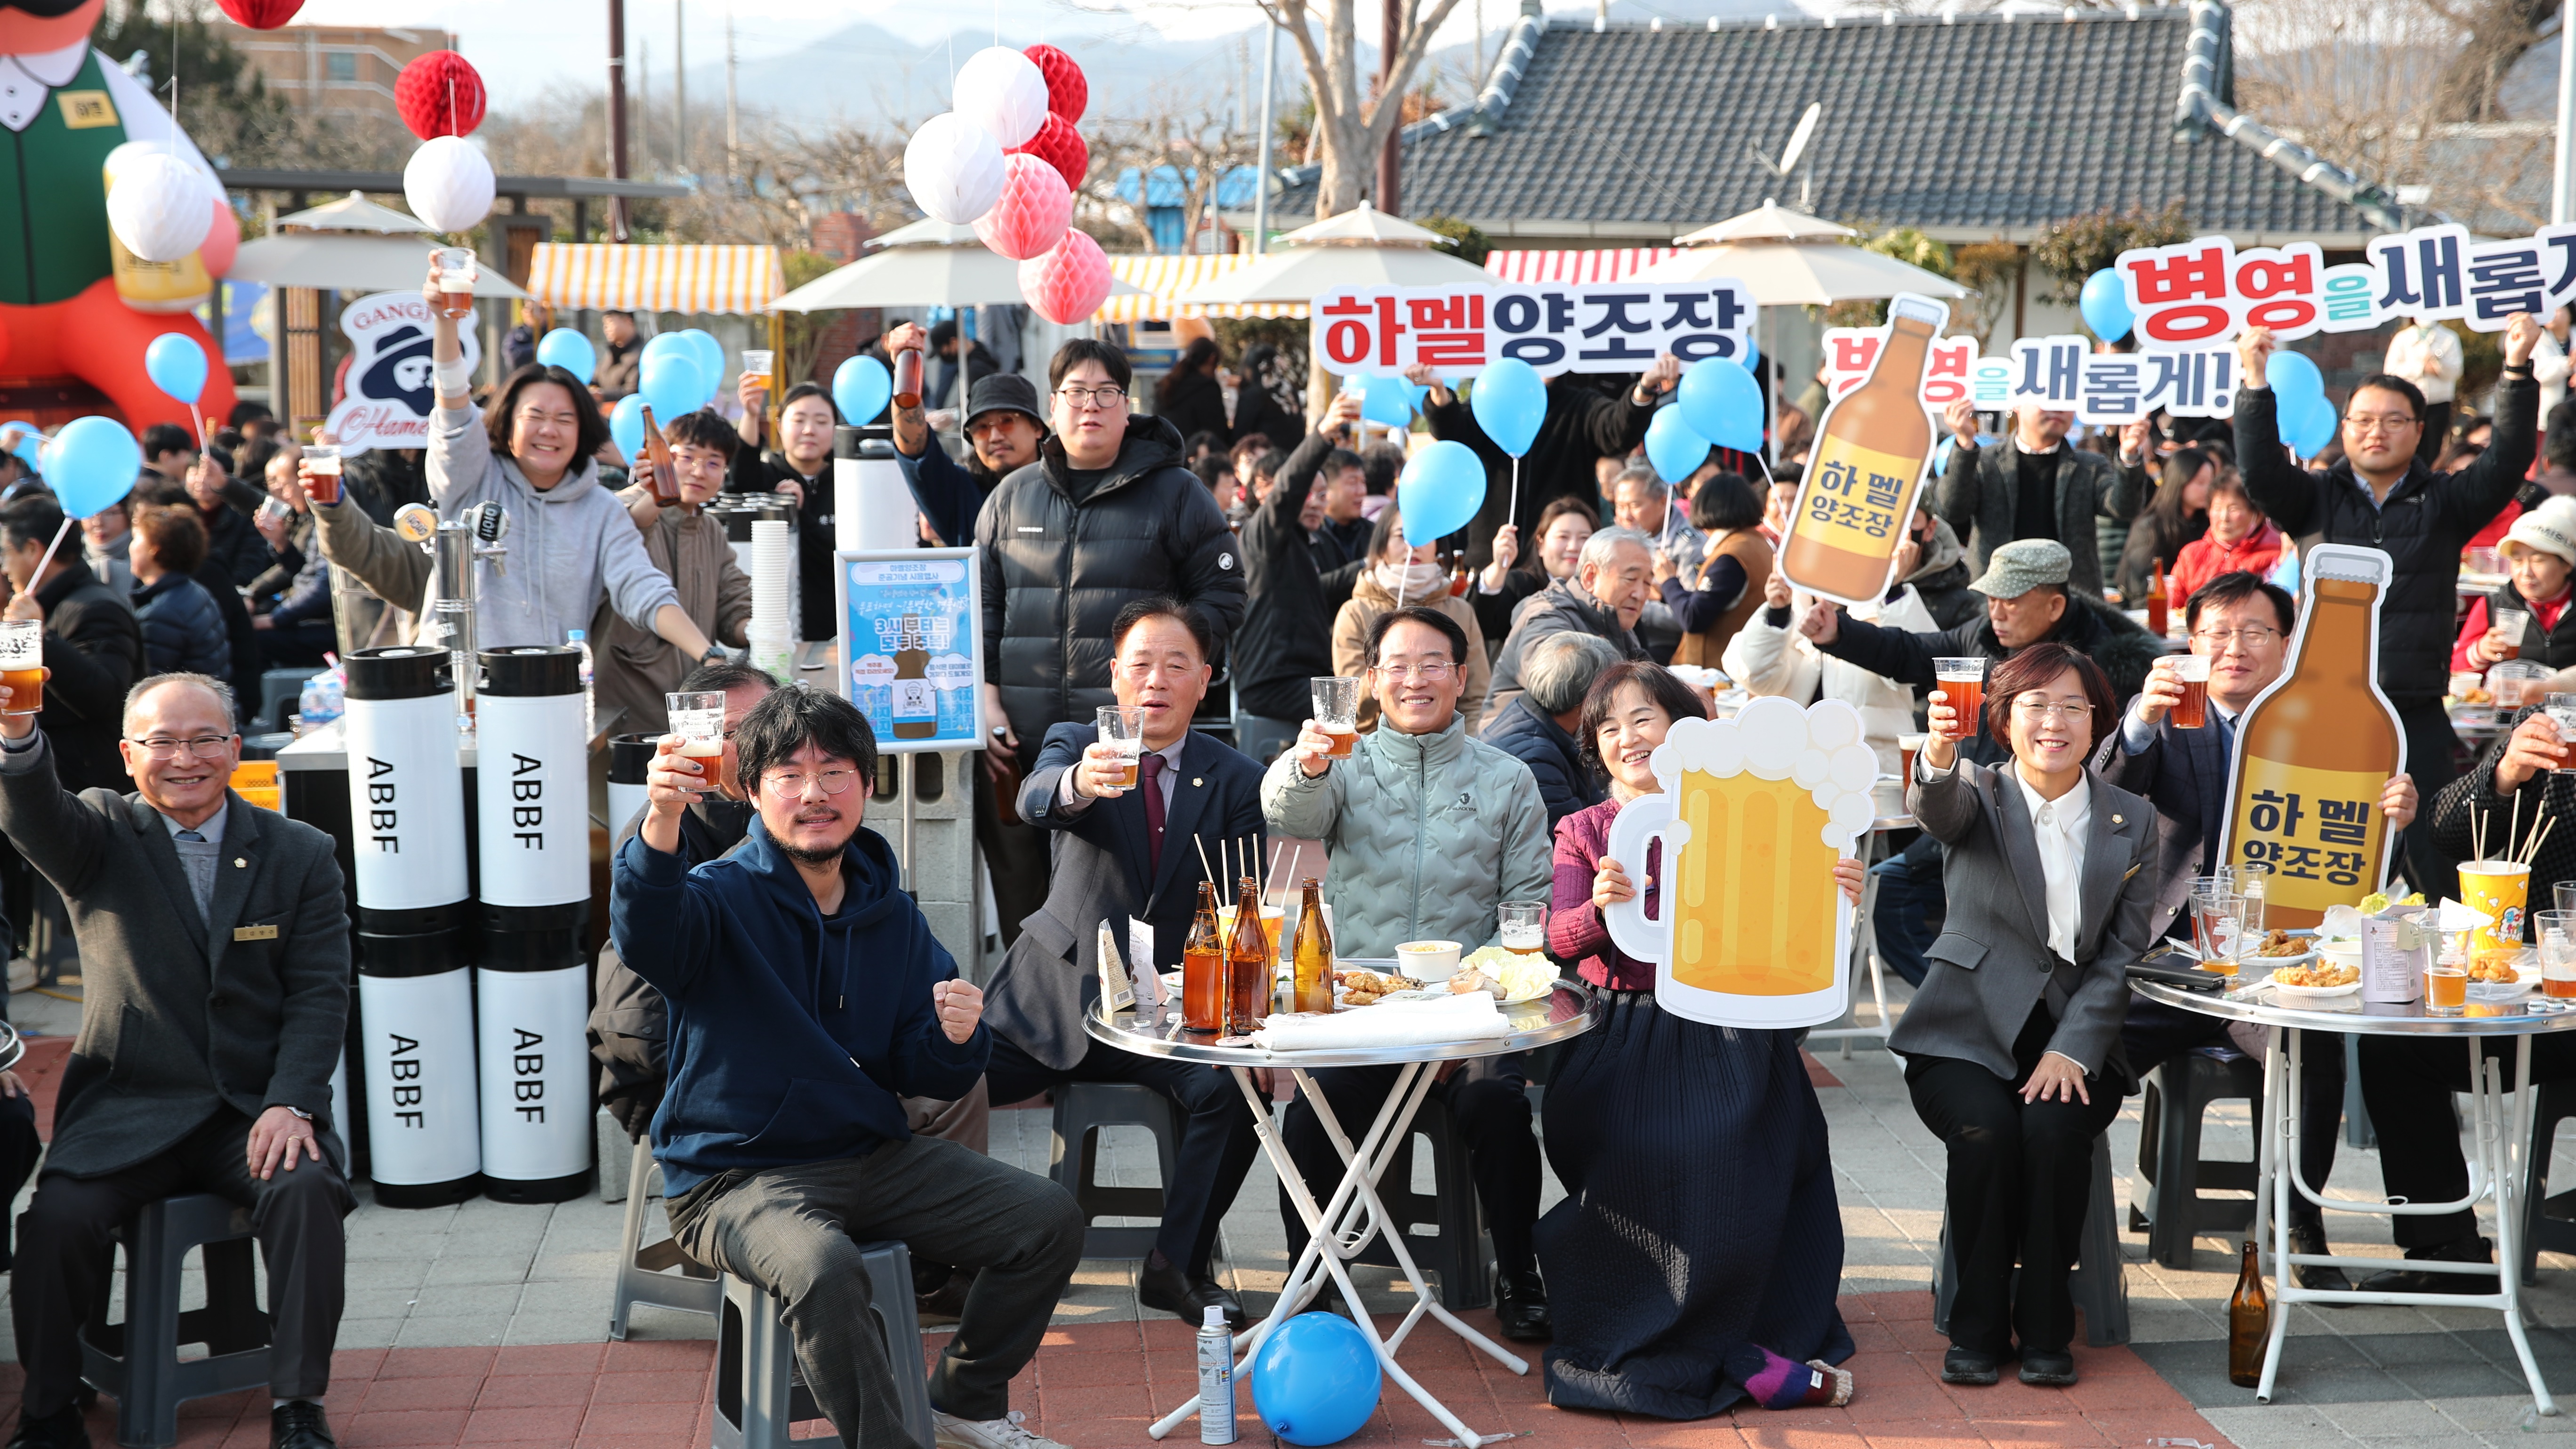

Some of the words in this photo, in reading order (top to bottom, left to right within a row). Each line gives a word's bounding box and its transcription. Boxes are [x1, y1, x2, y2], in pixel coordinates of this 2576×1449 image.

[2128, 247, 2371, 342] 병영을
[1322, 289, 1744, 366] 하멜양조장
[2016, 346, 2230, 414] 새롭게!
[337, 405, 429, 444] Hame
[1820, 459, 1904, 509] 하멜
[1811, 496, 1894, 538] 양조장
[875, 618, 902, 634] 3시
[880, 634, 911, 651] 모두
[913, 633, 950, 651] 주목!
[367, 757, 399, 853] ABBF
[512, 753, 543, 851] ABBF
[2250, 789, 2369, 846] 하멜
[2243, 840, 2366, 886] 양조장
[389, 1034, 424, 1129] ABBF
[513, 1028, 544, 1124] ABBF
